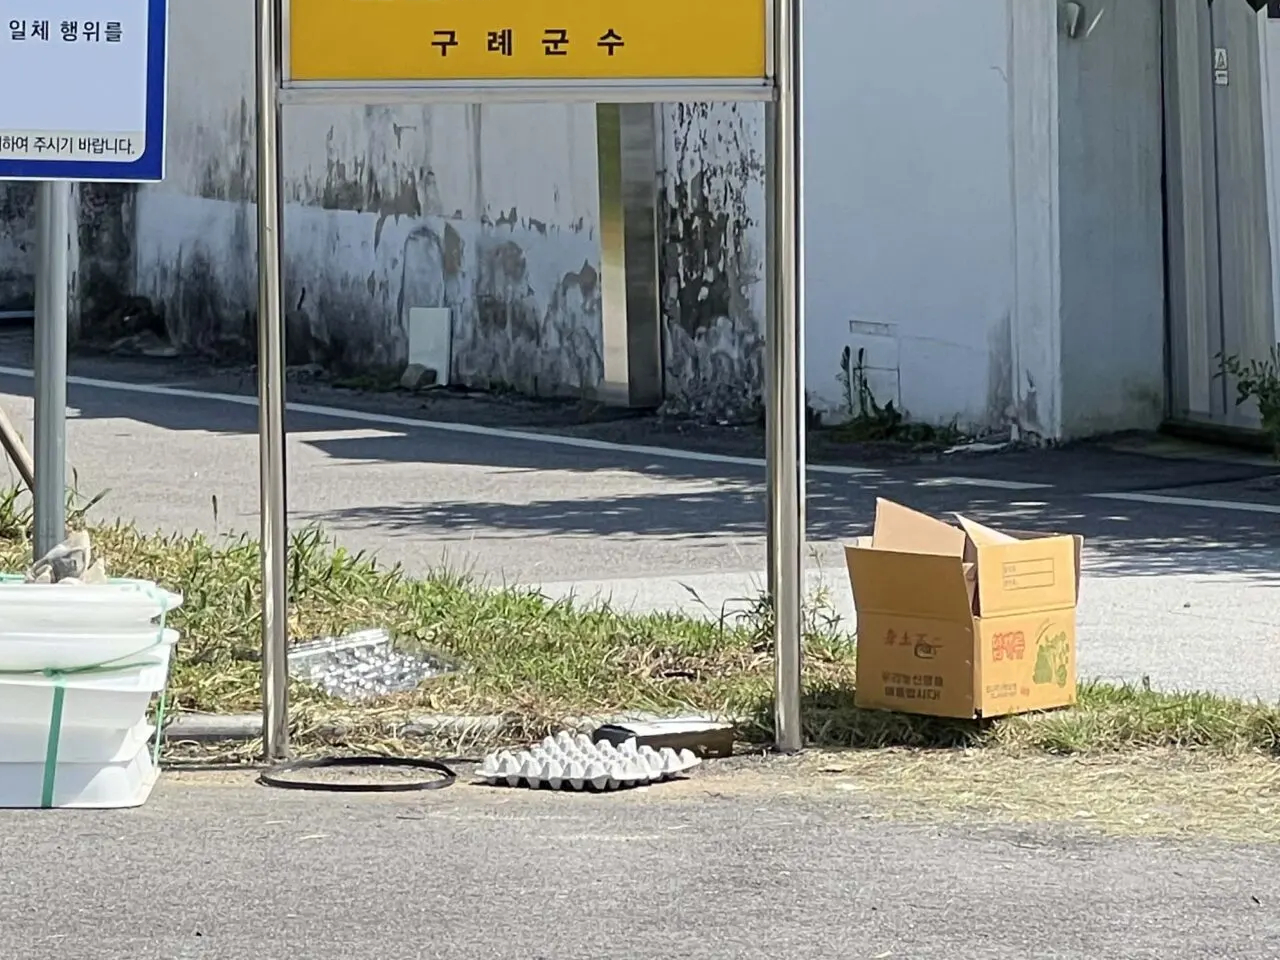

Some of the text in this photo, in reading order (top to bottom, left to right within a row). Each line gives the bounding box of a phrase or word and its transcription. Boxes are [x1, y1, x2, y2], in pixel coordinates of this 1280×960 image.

[8, 19, 51, 42] 일체
[59, 20, 124, 43] 행위를
[32, 135, 74, 155] 주시기
[78, 136, 136, 156] 바랍니다.
